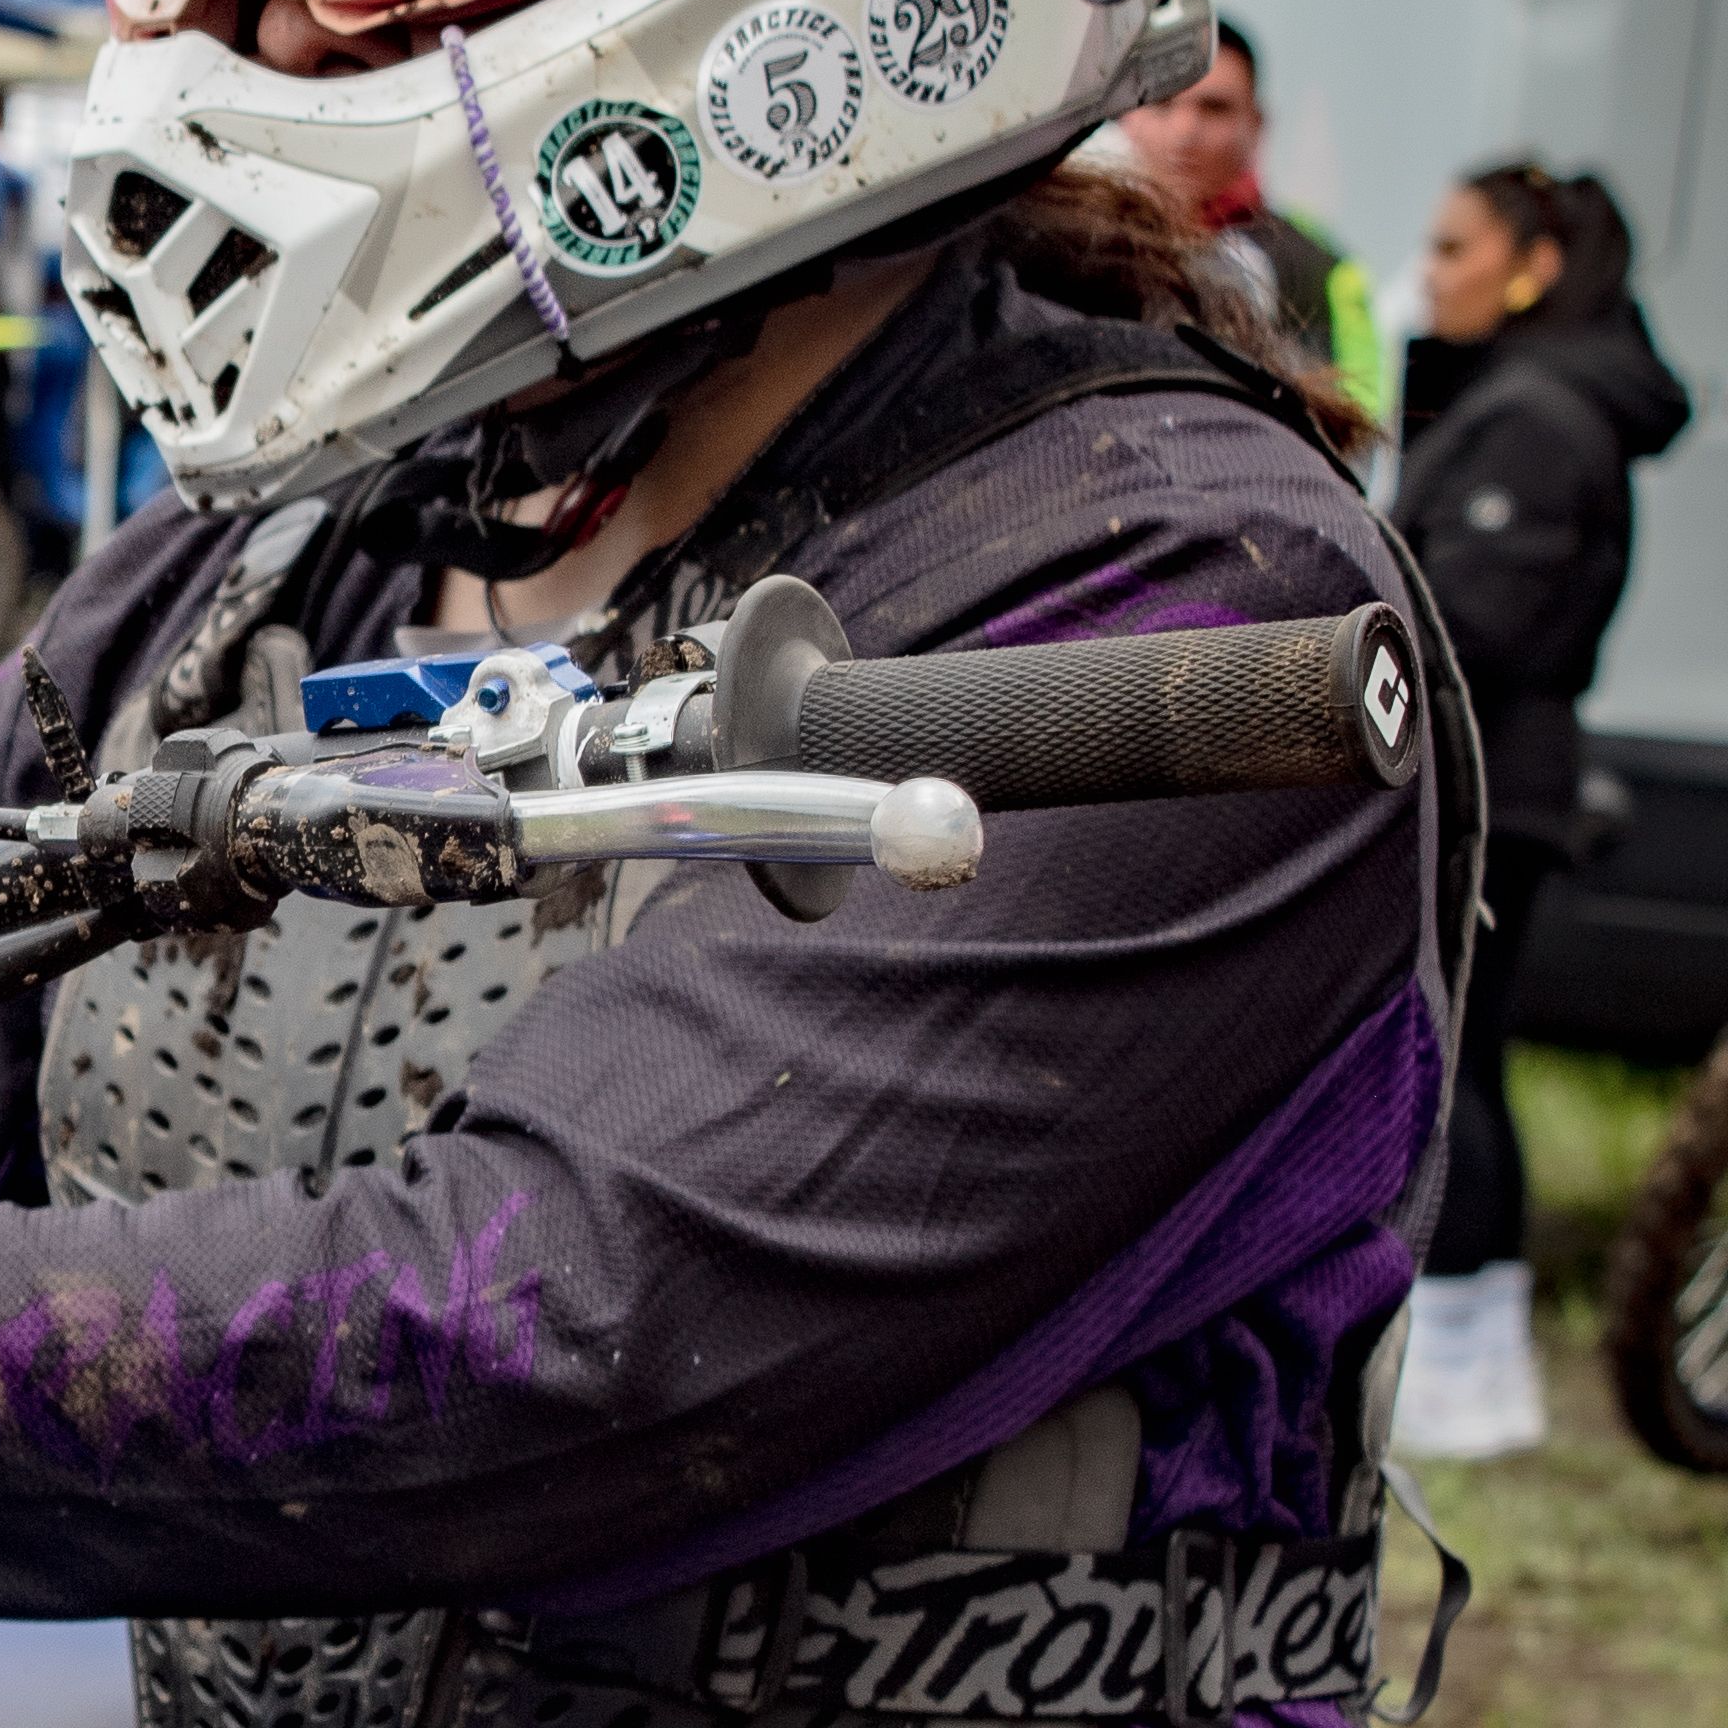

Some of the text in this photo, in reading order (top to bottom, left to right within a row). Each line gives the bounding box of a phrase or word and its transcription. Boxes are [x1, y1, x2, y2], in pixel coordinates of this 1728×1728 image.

[723, 8, 840, 63] PRACTICE
[763, 48, 818, 131] 5
[561, 131, 665, 237] 14
